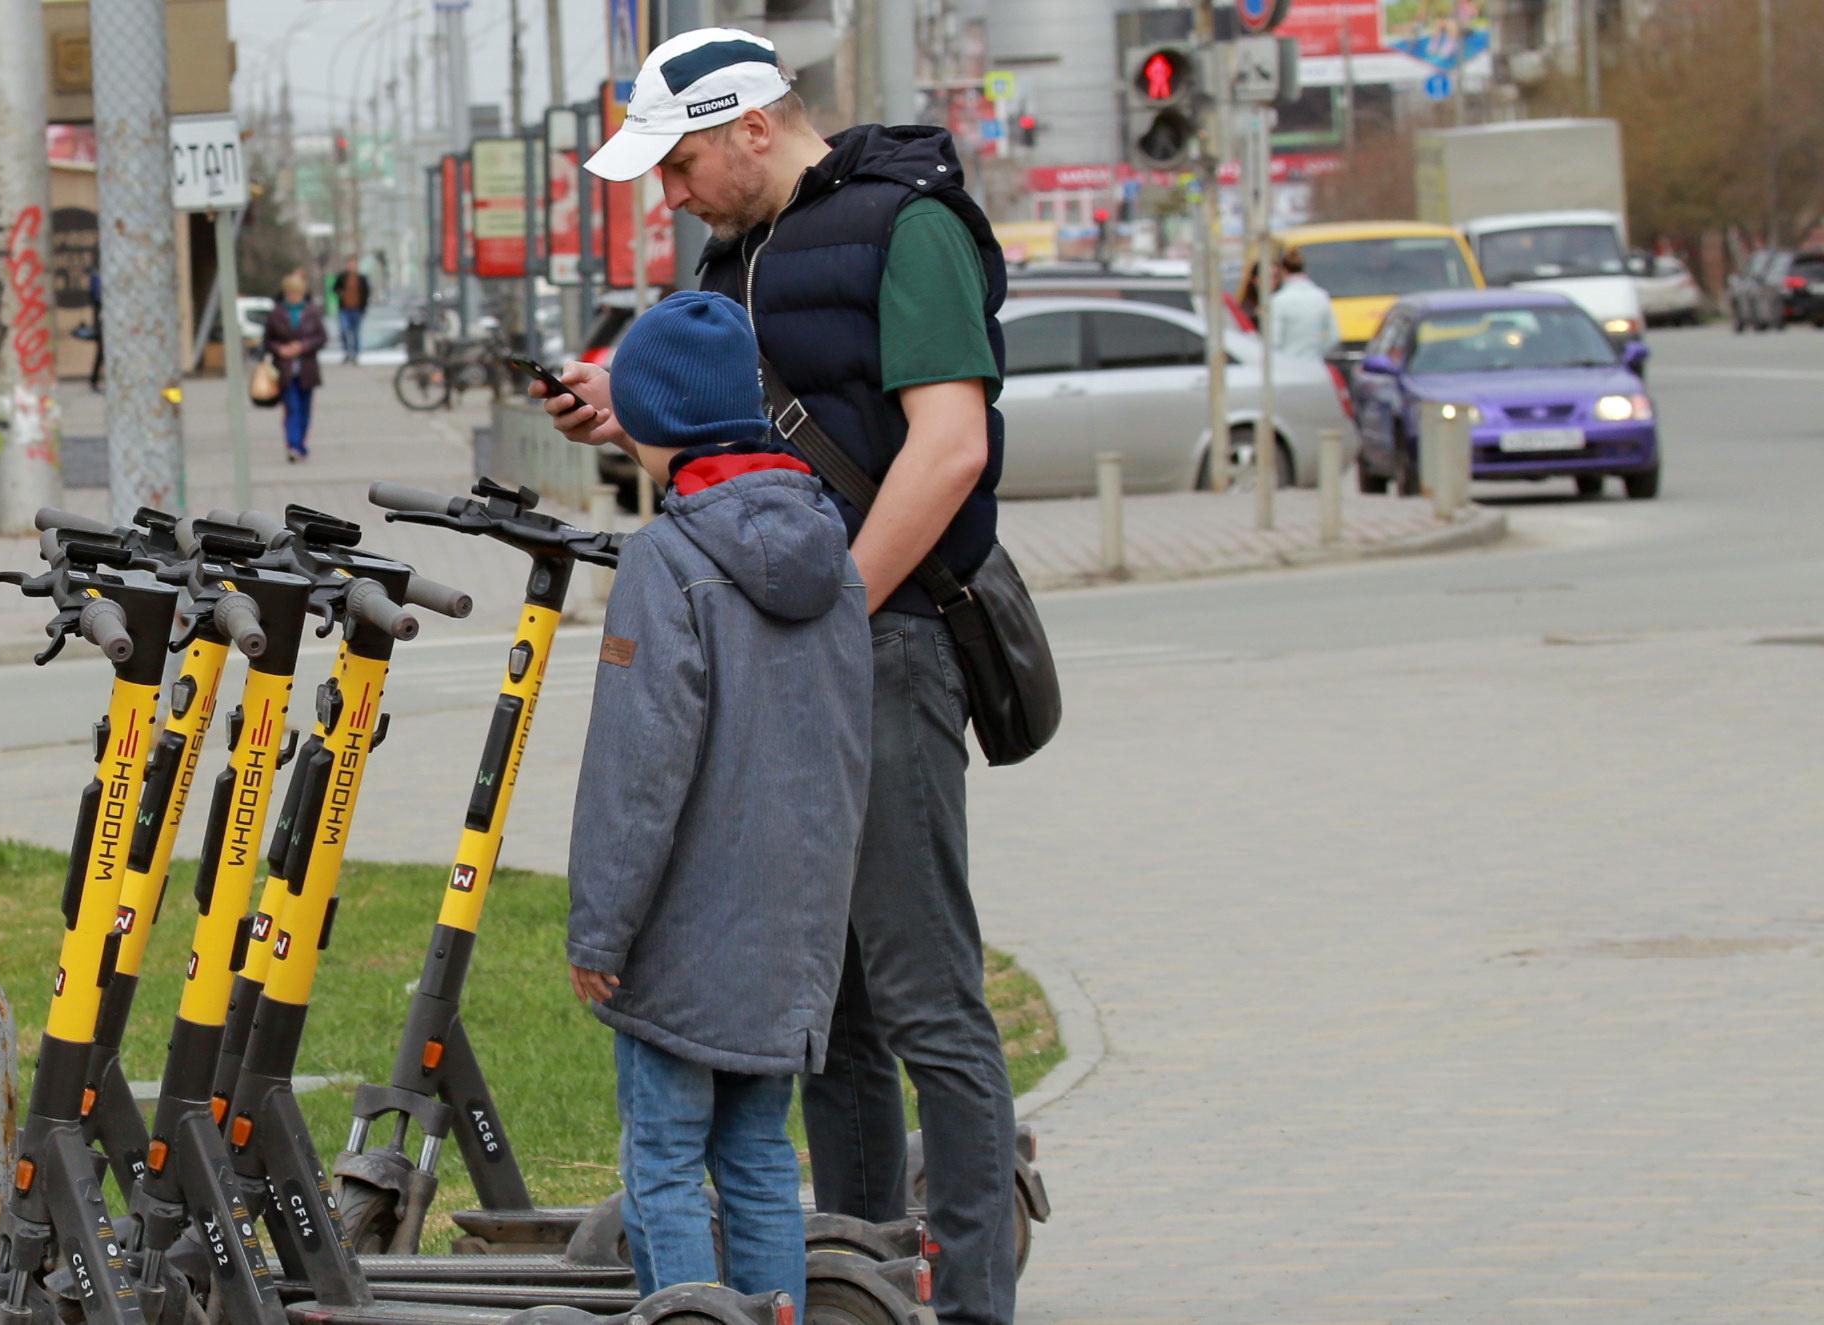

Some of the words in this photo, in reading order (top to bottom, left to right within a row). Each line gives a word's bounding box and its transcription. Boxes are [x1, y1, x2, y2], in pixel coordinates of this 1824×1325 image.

[689, 96, 736, 116] PETRONAS
[173, 143, 239, 187] СТОП
[169, 715, 210, 826] WHOOSH
[322, 732, 363, 846] WHOOSH
[95, 761, 133, 881] WHOOSH
[227, 749, 266, 867] WHOOSH
[472, 1110, 498, 1152] AC66
[291, 1195, 314, 1237] CF14
[204, 1218, 229, 1266] AJ92
[72, 1253, 94, 1298] CK51
